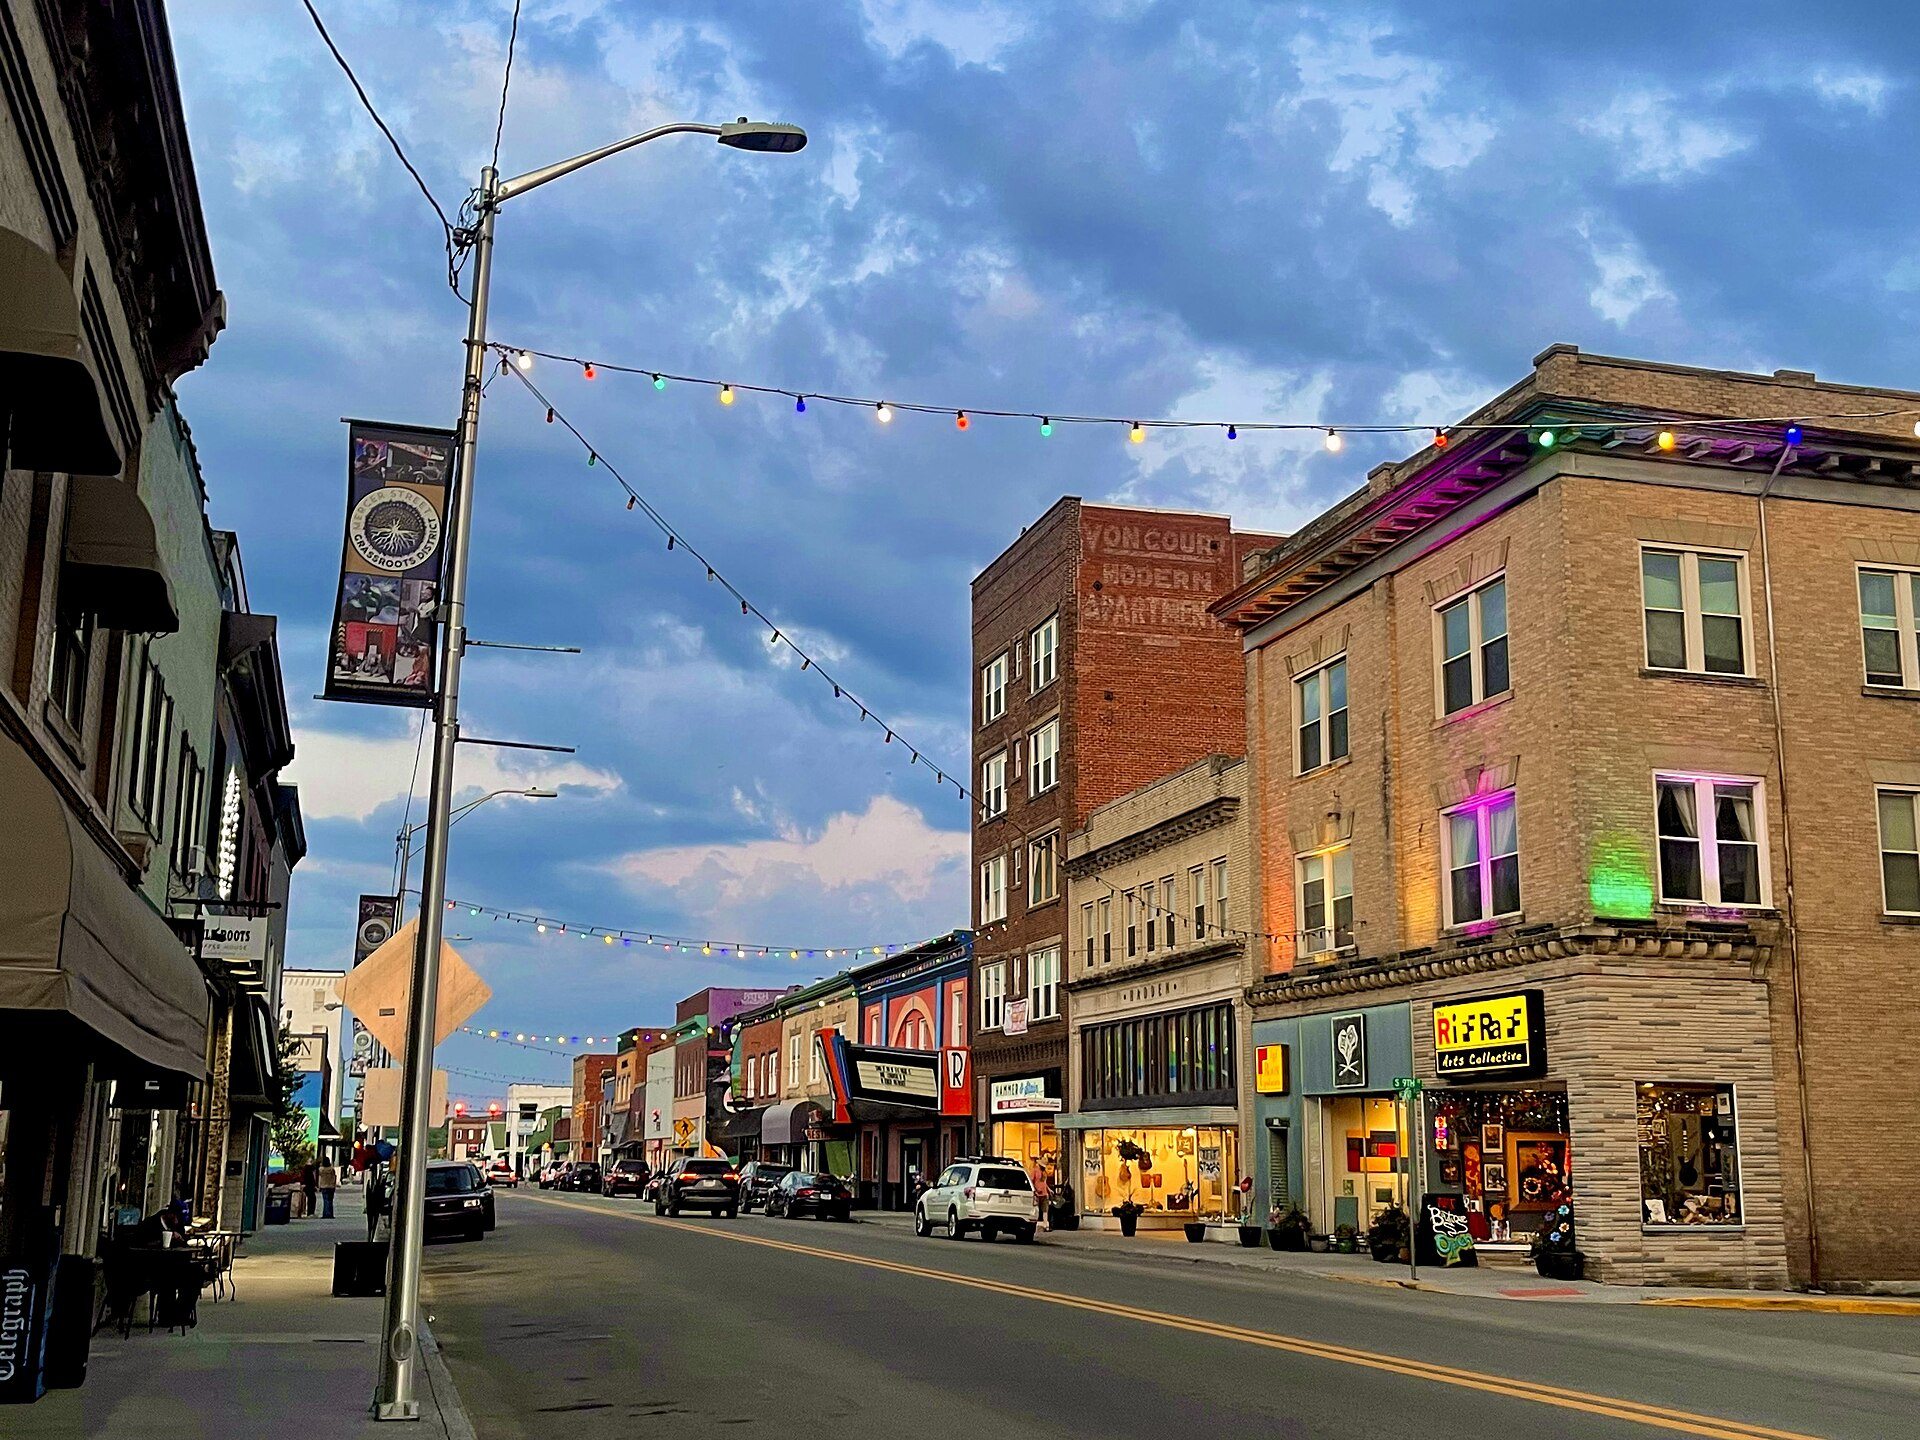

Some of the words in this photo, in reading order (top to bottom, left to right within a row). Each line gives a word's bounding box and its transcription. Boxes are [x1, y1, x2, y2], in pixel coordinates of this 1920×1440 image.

[353, 492, 384, 529] MERCER
[390, 490, 432, 514] STREET
[354, 534, 416, 568] GRASSROOTS
[416, 517, 437, 560] DISTRICT
[1103, 563, 1213, 593] MODERN
[1442, 1055, 1465, 1068] Arts
[1468, 1051, 1522, 1065] Collective
[1394, 1078, 1400, 1087] S
[1402, 1078, 1416, 1087] 9TH
[0, 1269, 30, 1381] Telegraph
